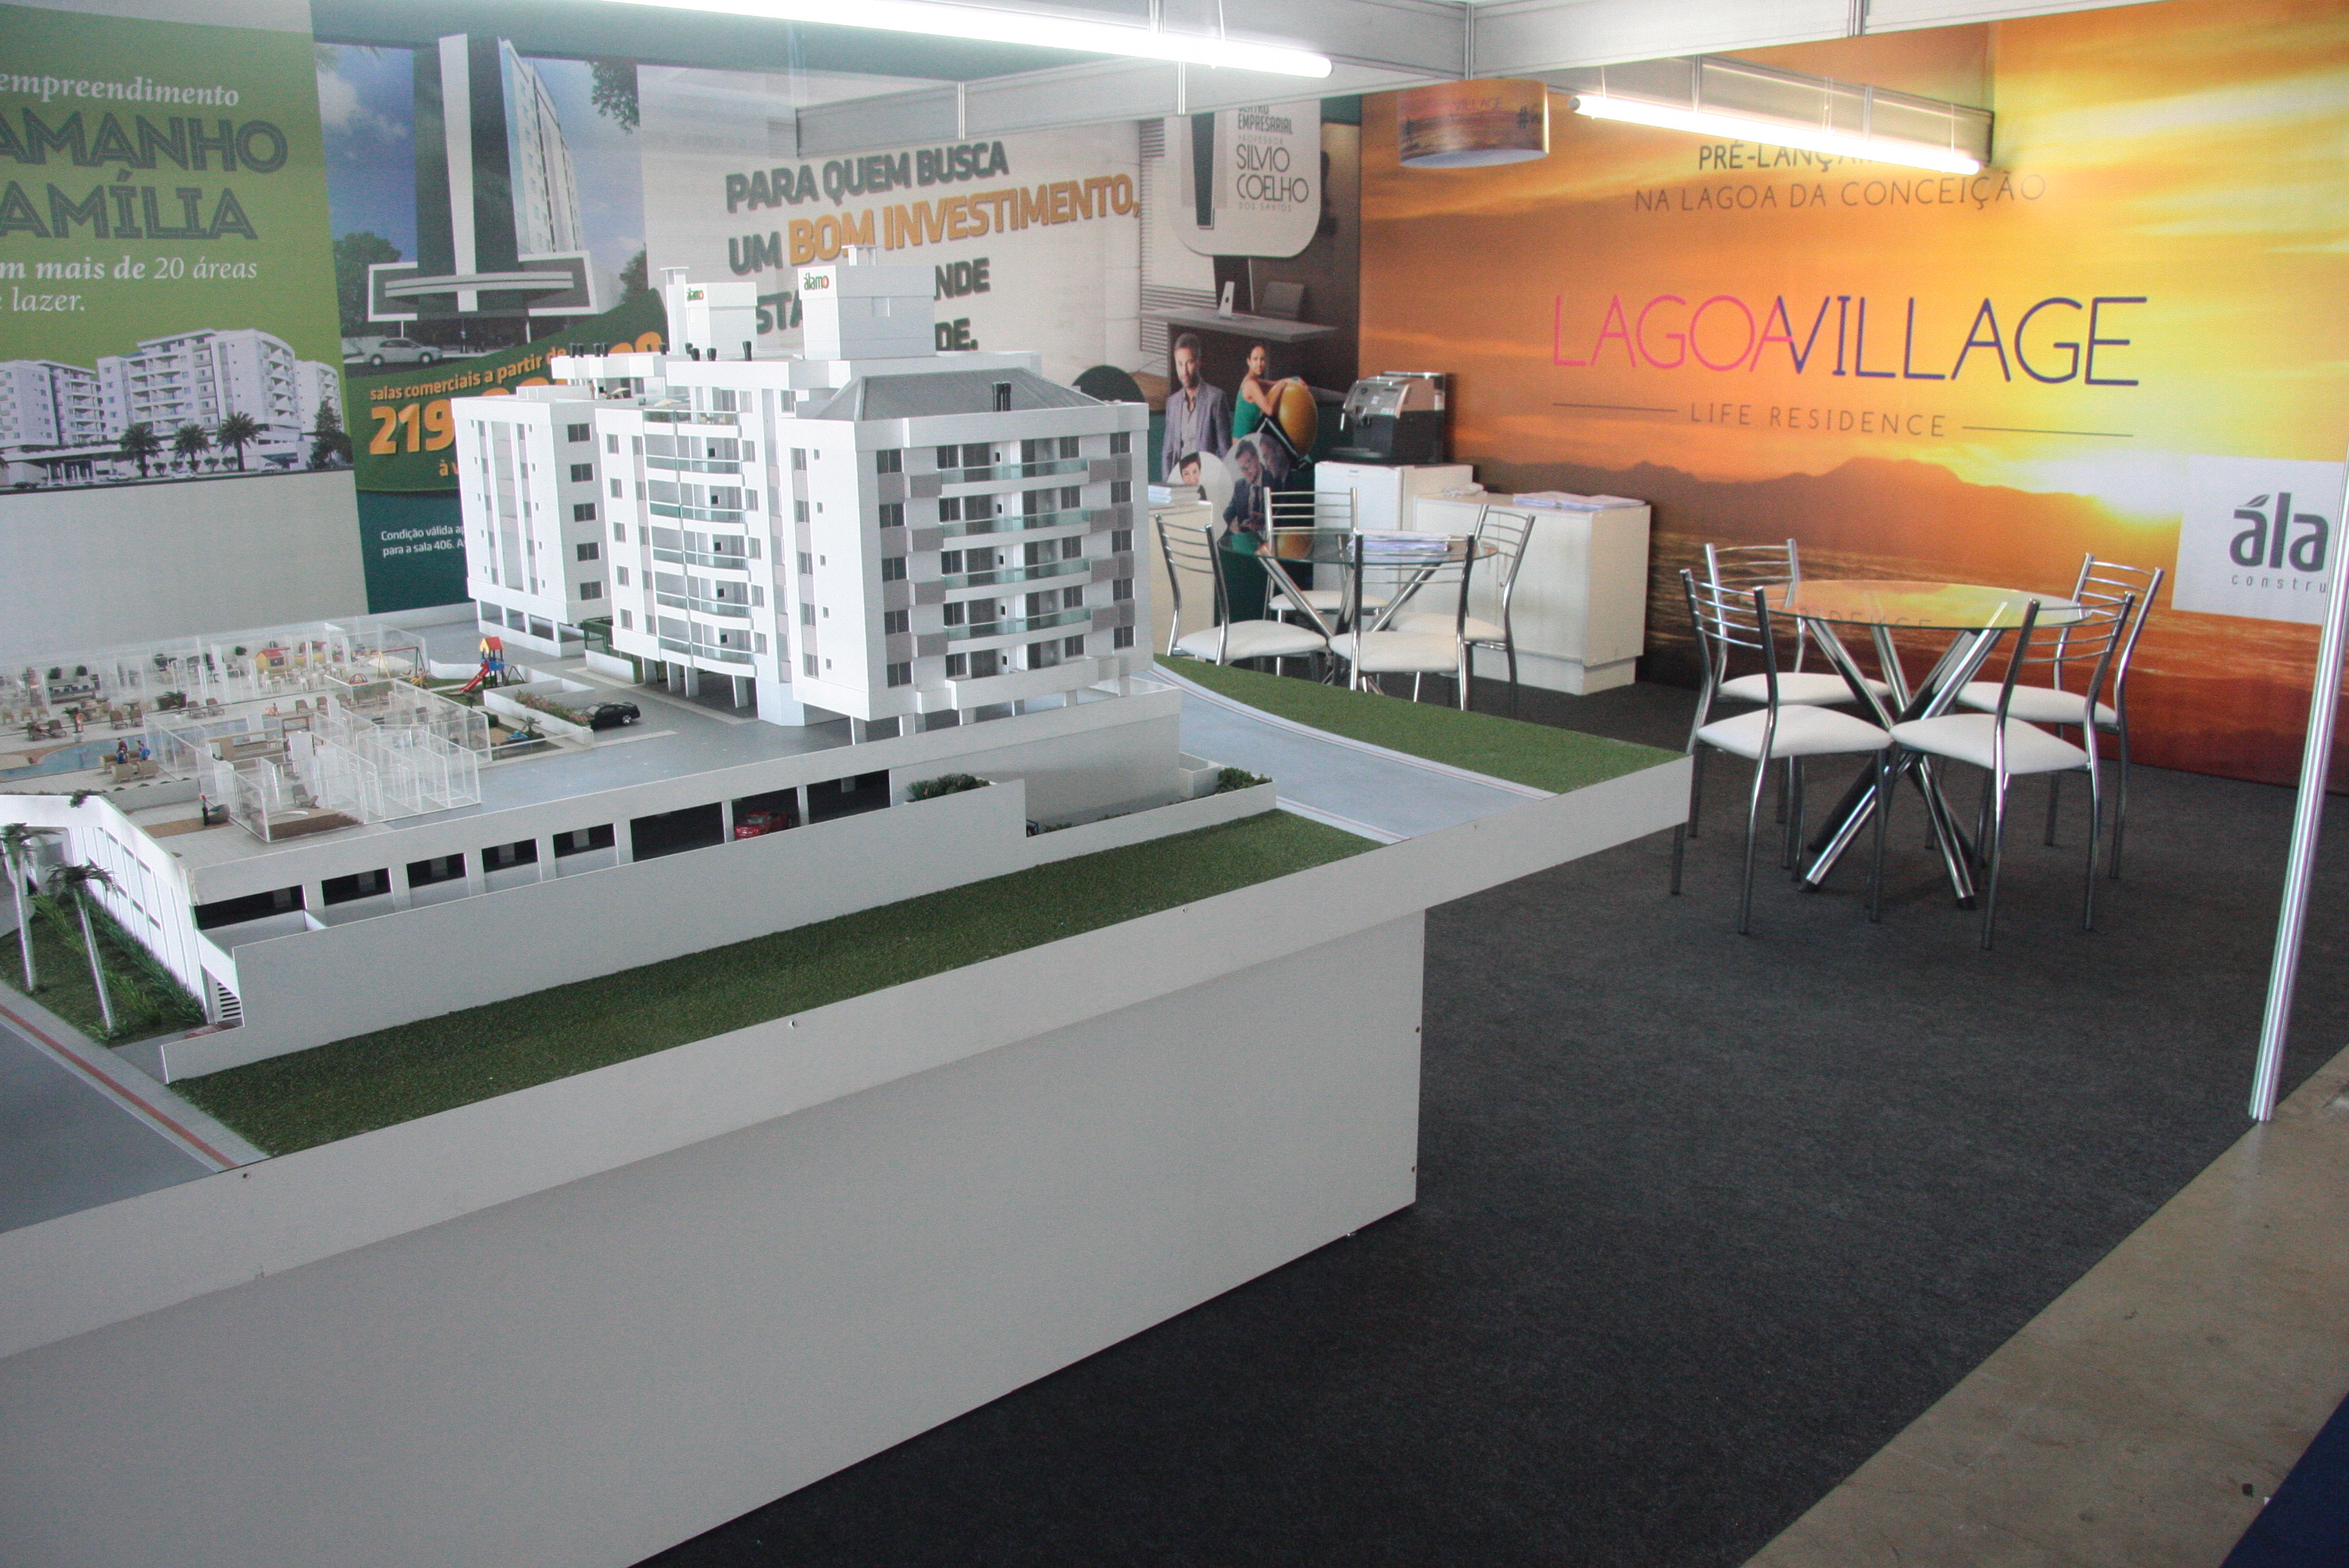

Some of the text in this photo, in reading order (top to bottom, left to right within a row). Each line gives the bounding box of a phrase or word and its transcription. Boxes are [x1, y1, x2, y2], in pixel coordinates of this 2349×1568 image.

[0, 73, 239, 107] empreendimento
[1238, 113, 1293, 134] EMPRESARIAL
[1236, 143, 1290, 173] SILVIO
[726, 141, 1010, 214] PARA QUEM BUSCA
[1236, 173, 1309, 203] COELHO
[1635, 169, 2047, 212] NA LAGOA DA CONCEIÇÃO
[728, 173, 1140, 275] UM BOM INVESTIMENTO,
[36, 257, 105, 279] mais
[114, 255, 146, 279] de
[153, 257, 184, 279] 20
[193, 256, 258, 279] áreas
[803, 272, 830, 290] álamo
[13, 286, 85, 312] lazer.
[370, 385, 402, 401] salas
[405, 371, 480, 399] comerciais
[484, 369, 494, 383] a
[496, 353, 542, 384] partir
[1690, 402, 1947, 438] LIFE RESIDENCE
[381, 528, 424, 541] Condição
[425, 525, 453, 536] válida
[383, 545, 404, 558] para
[405, 545, 412, 554] a
[413, 542, 432, 552] sala
[434, 540, 455, 550] 406.
